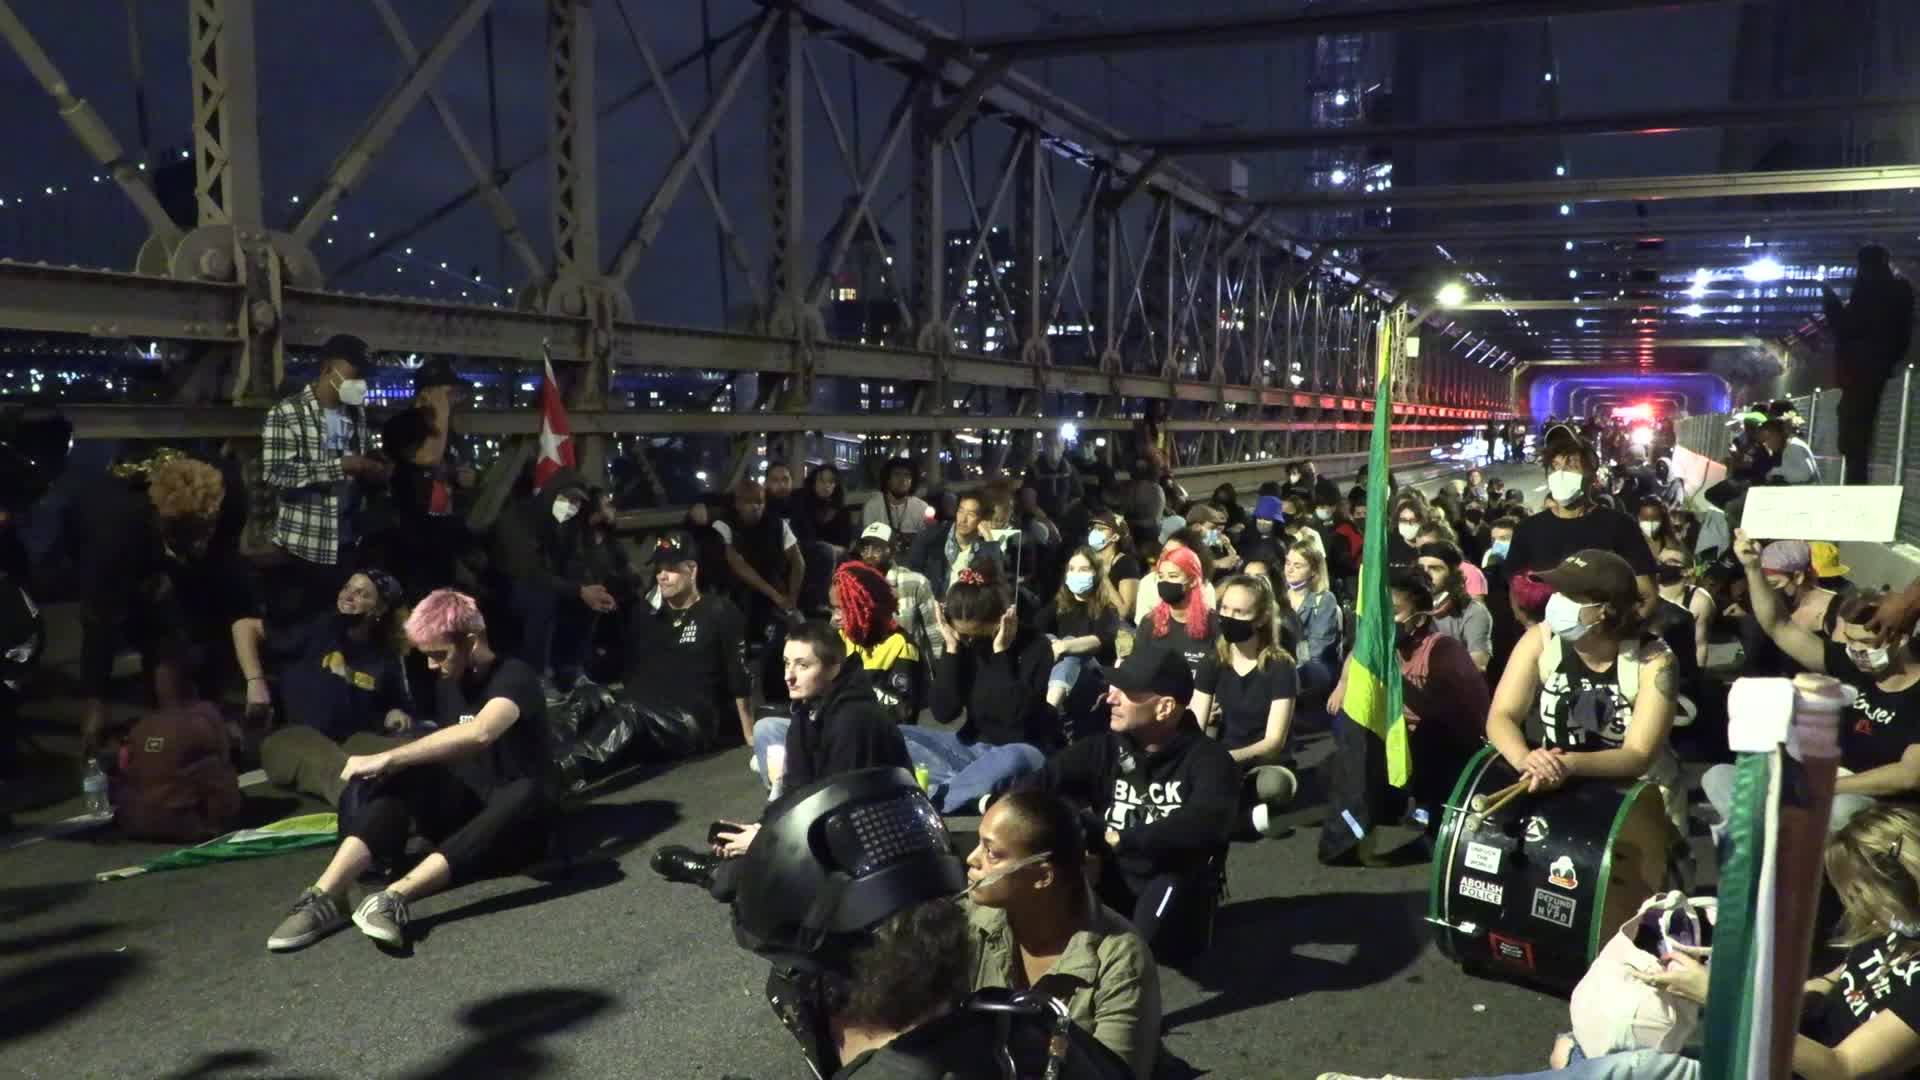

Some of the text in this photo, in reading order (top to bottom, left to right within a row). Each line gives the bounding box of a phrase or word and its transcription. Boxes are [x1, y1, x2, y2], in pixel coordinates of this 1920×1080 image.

[1114, 779, 1182, 805] BLCK
[1460, 876, 1503, 895] ABOLISH
[1461, 885, 1501, 904] POLICE
[1538, 892, 1571, 908] DEFUND
[1538, 906, 1567, 922] NYPD
